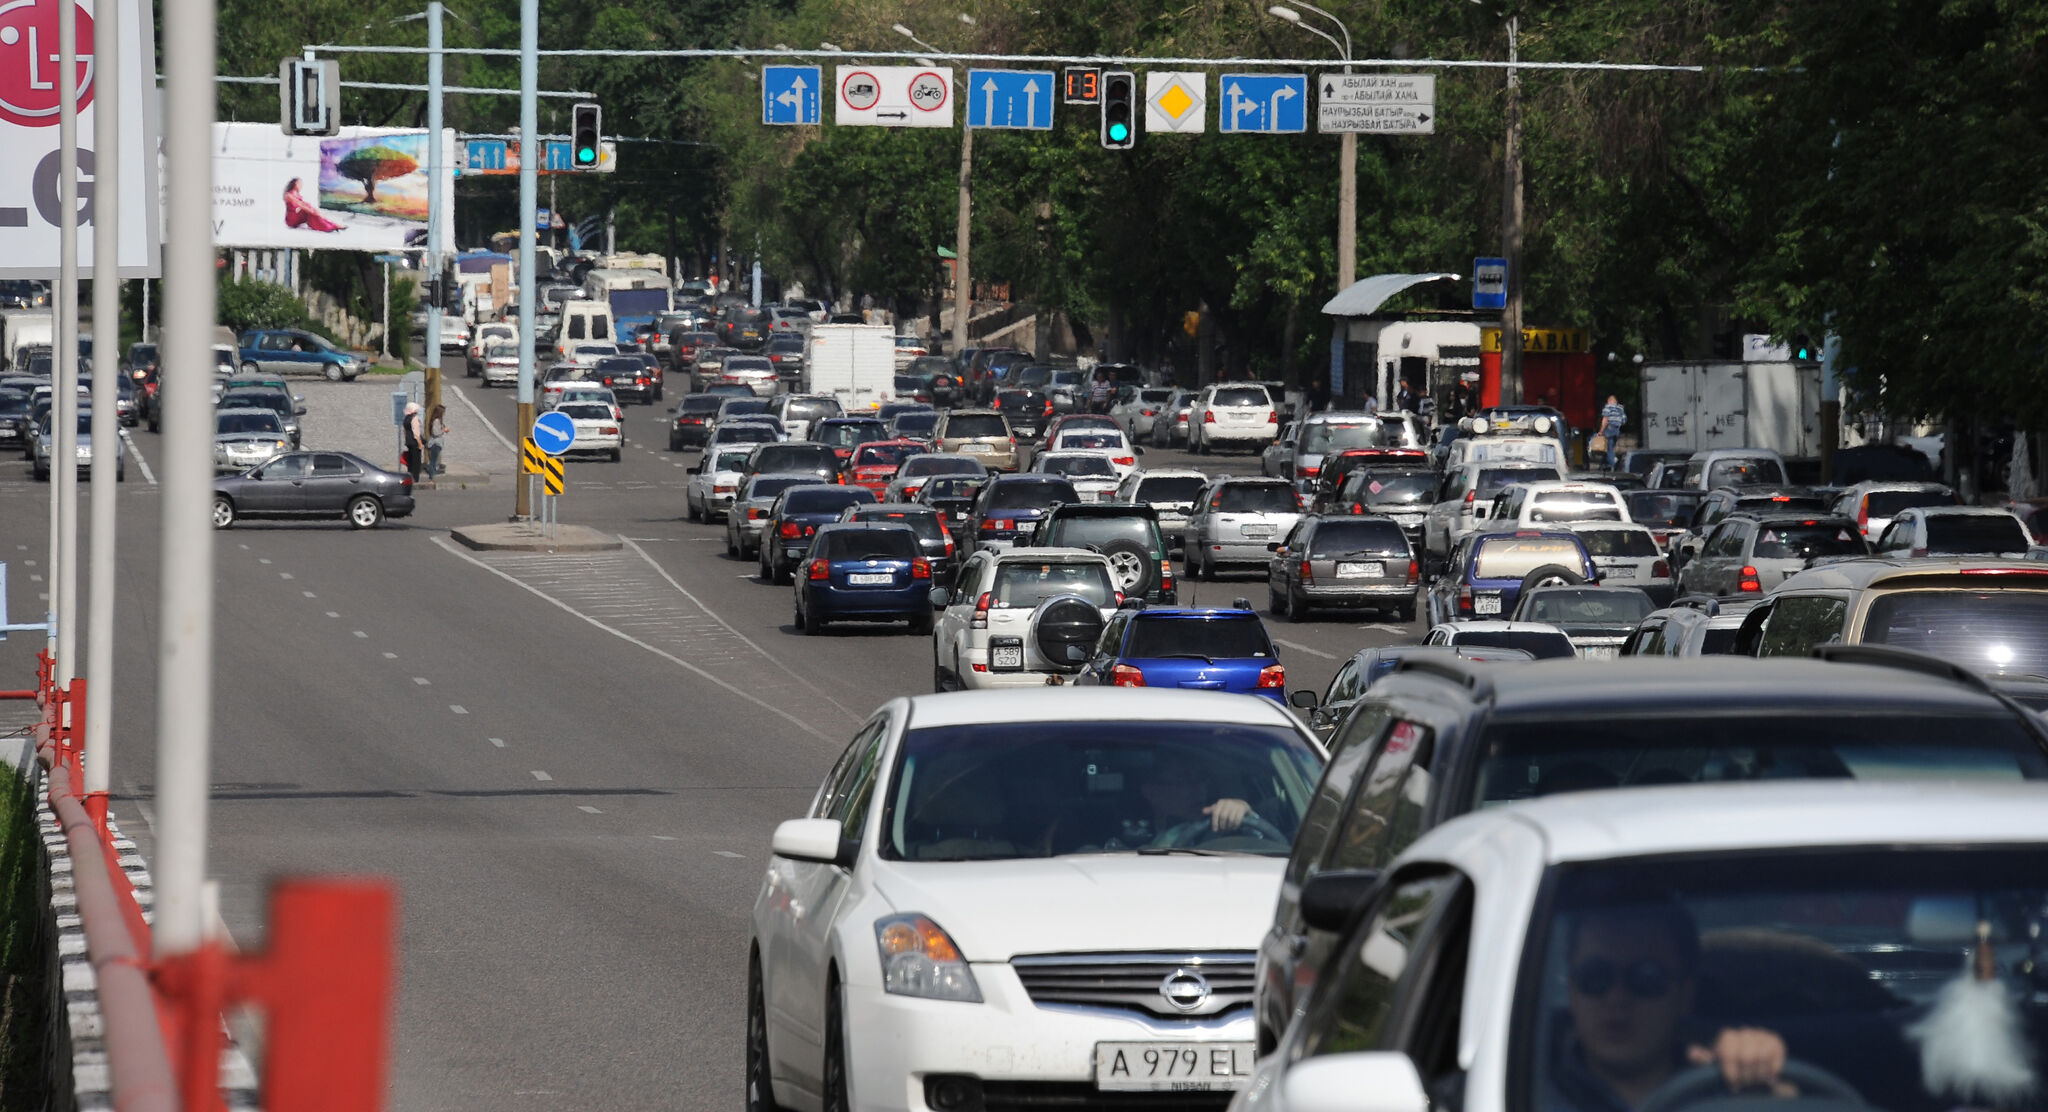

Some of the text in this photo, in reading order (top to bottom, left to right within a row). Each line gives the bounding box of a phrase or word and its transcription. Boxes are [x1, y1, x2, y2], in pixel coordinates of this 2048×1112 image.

[1068, 73, 1097, 98] 13
[1342, 78, 1377, 88] АБЫЛАЙ
[1380, 78, 1397, 88] ХАН
[1354, 89, 1392, 100] АБЫЛАЙ
[1395, 91, 1418, 100] ХАНА
[1322, 106, 1374, 117] НАУРЫЗБАЙ
[1375, 107, 1403, 116] БАТЫР
[1383, 120, 1417, 129] БАТЫРА
[1494, 332, 1580, 351] КРАВАН
[994, 647, 1020, 656] A 589
[998, 656, 1017, 665] SZO
[1111, 1049, 1250, 1077] A 979 EL
